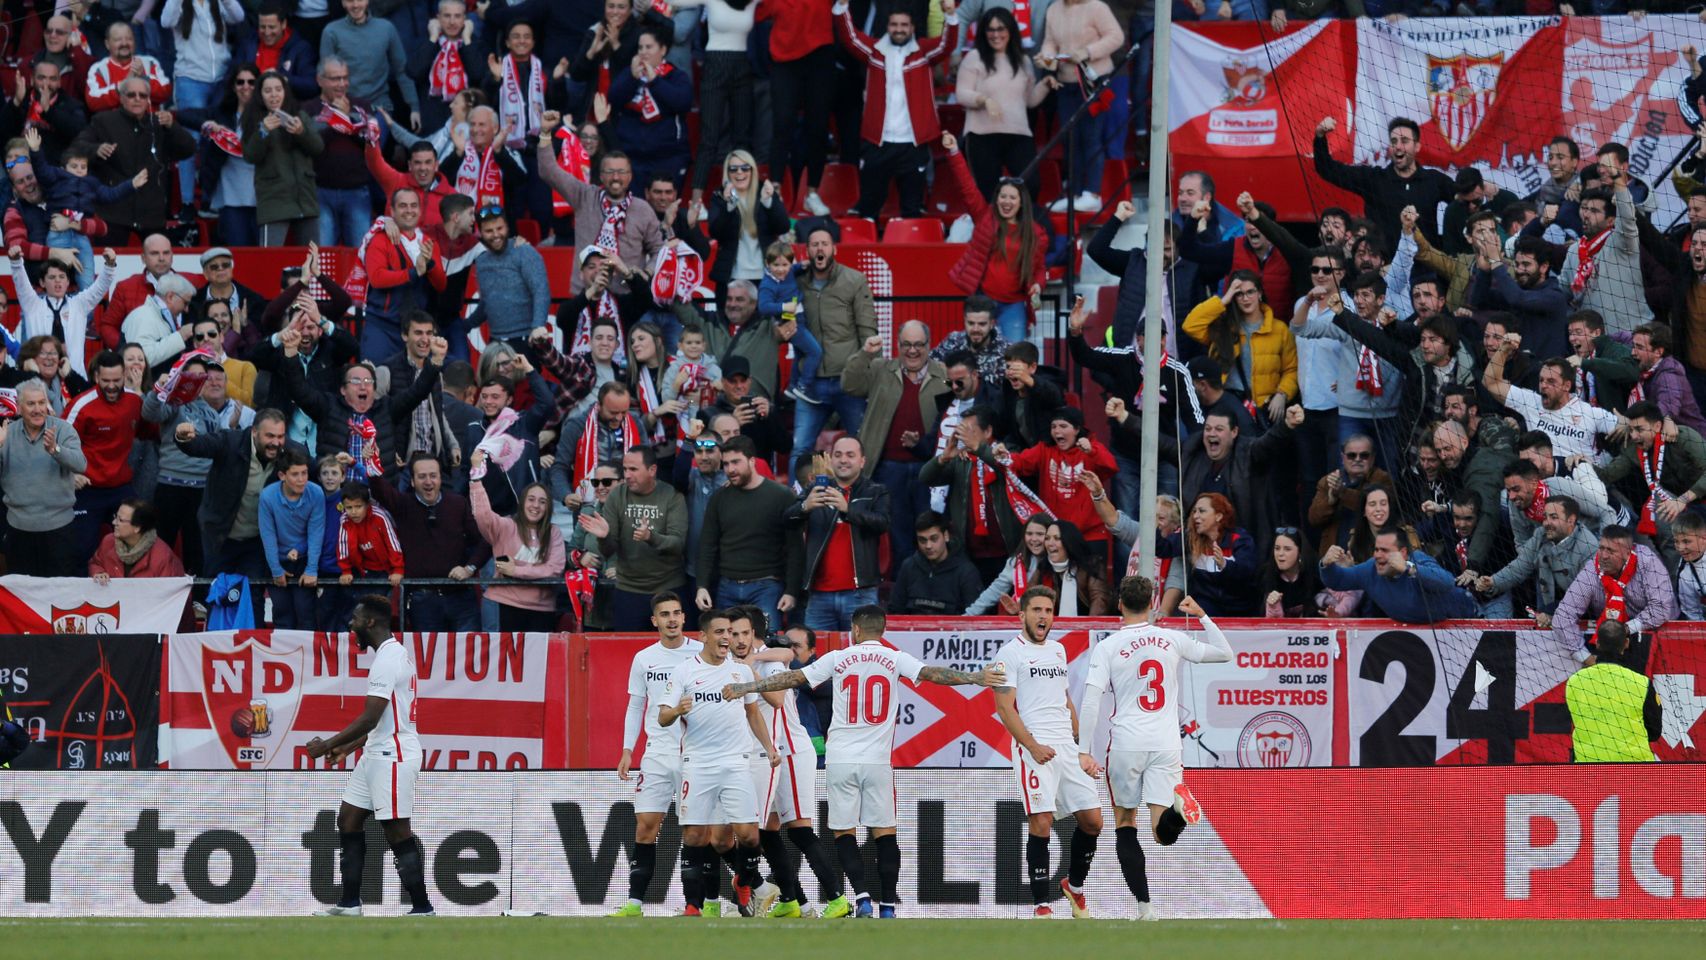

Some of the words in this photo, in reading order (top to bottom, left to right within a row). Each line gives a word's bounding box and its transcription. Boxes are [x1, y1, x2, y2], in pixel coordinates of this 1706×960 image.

[1494, 25, 1514, 37] DE
[1537, 419, 1585, 439] Playtika
[627, 508, 659, 519] TIFOSI
[313, 632, 525, 682] NEVION
[923, 635, 1005, 660] PAÑOLET
[1120, 636, 1170, 658] S.GOMEZ
[834, 655, 859, 674] EVER
[861, 653, 896, 674] BANEGA
[212, 660, 245, 693] N
[262, 661, 294, 693] D
[646, 671, 672, 682] Play
[1137, 659, 1166, 713] 3
[695, 692, 721, 703] Play
[841, 675, 890, 725] 10
[240, 750, 263, 760] SFC
[960, 741, 976, 758] 16
[1029, 770, 1039, 789] 6
[681, 780, 689, 800] 9
[125, 809, 257, 904] to
[552, 801, 1070, 905] WLD
[1505, 794, 1706, 899] Pla
